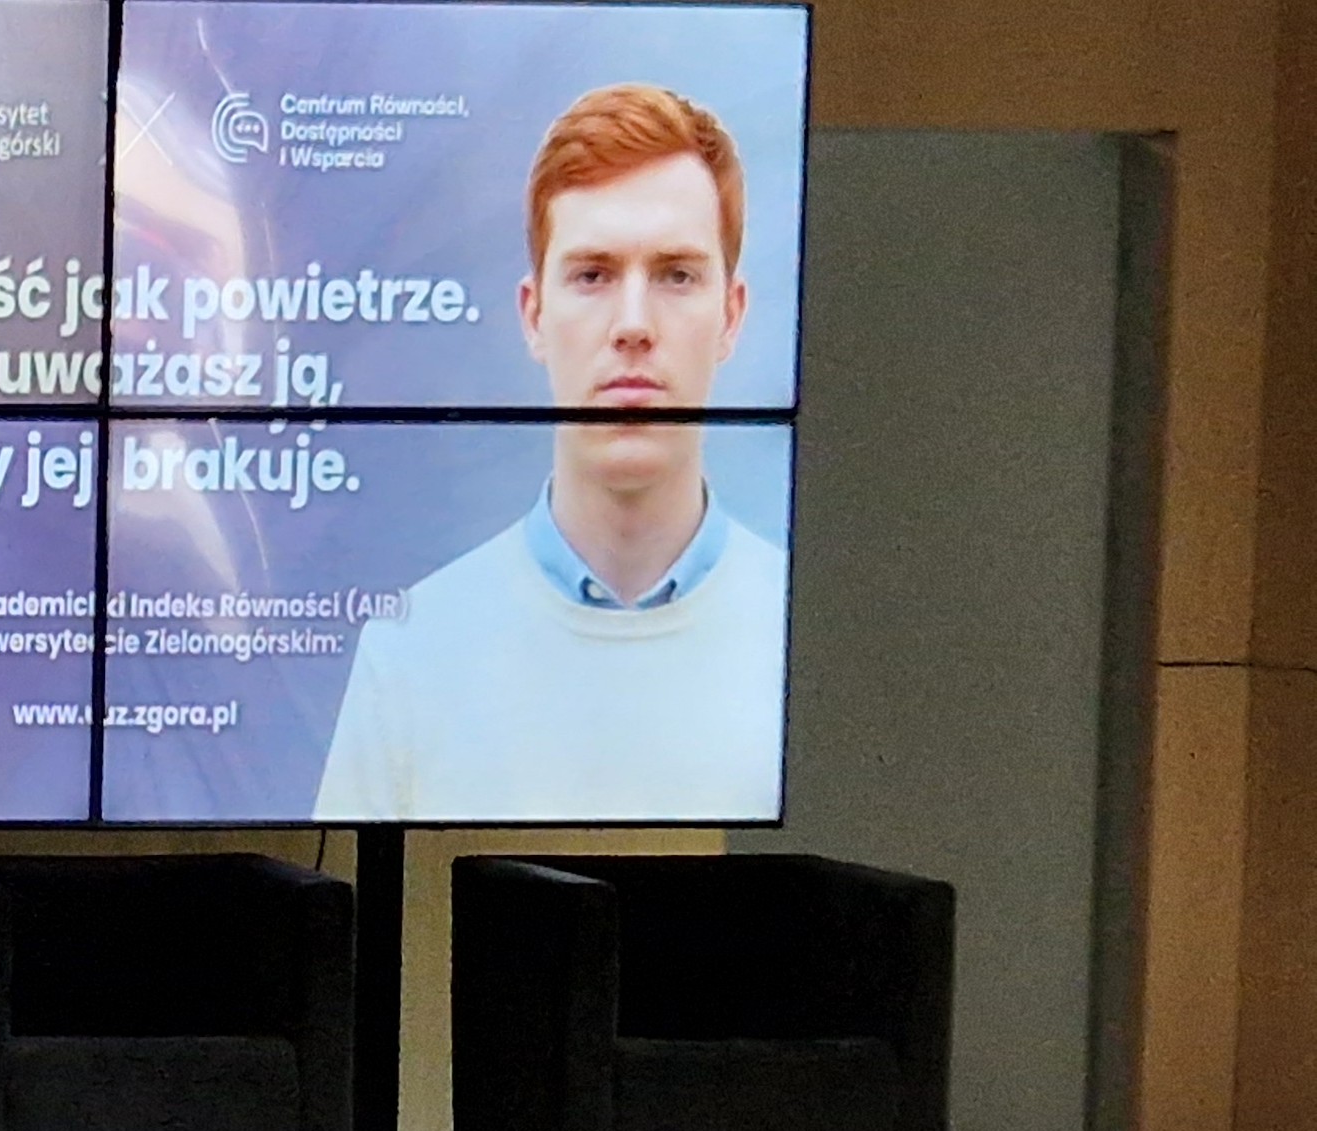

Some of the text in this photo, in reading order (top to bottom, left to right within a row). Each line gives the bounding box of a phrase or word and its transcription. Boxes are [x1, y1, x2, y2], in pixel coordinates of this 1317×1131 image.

[280, 93, 366, 115] Centrum
[291, 145, 384, 172] Wsparcia
[60, 257, 169, 338] jak
[183, 261, 480, 339] powietrze.
[271, 337, 344, 407] ją,
[21, 430, 95, 508] jej
[123, 433, 361, 510] brakuje.
[132, 591, 215, 619] Indeks
[220, 591, 340, 620] Równości
[145, 626, 344, 662] Zielonogórskim:
